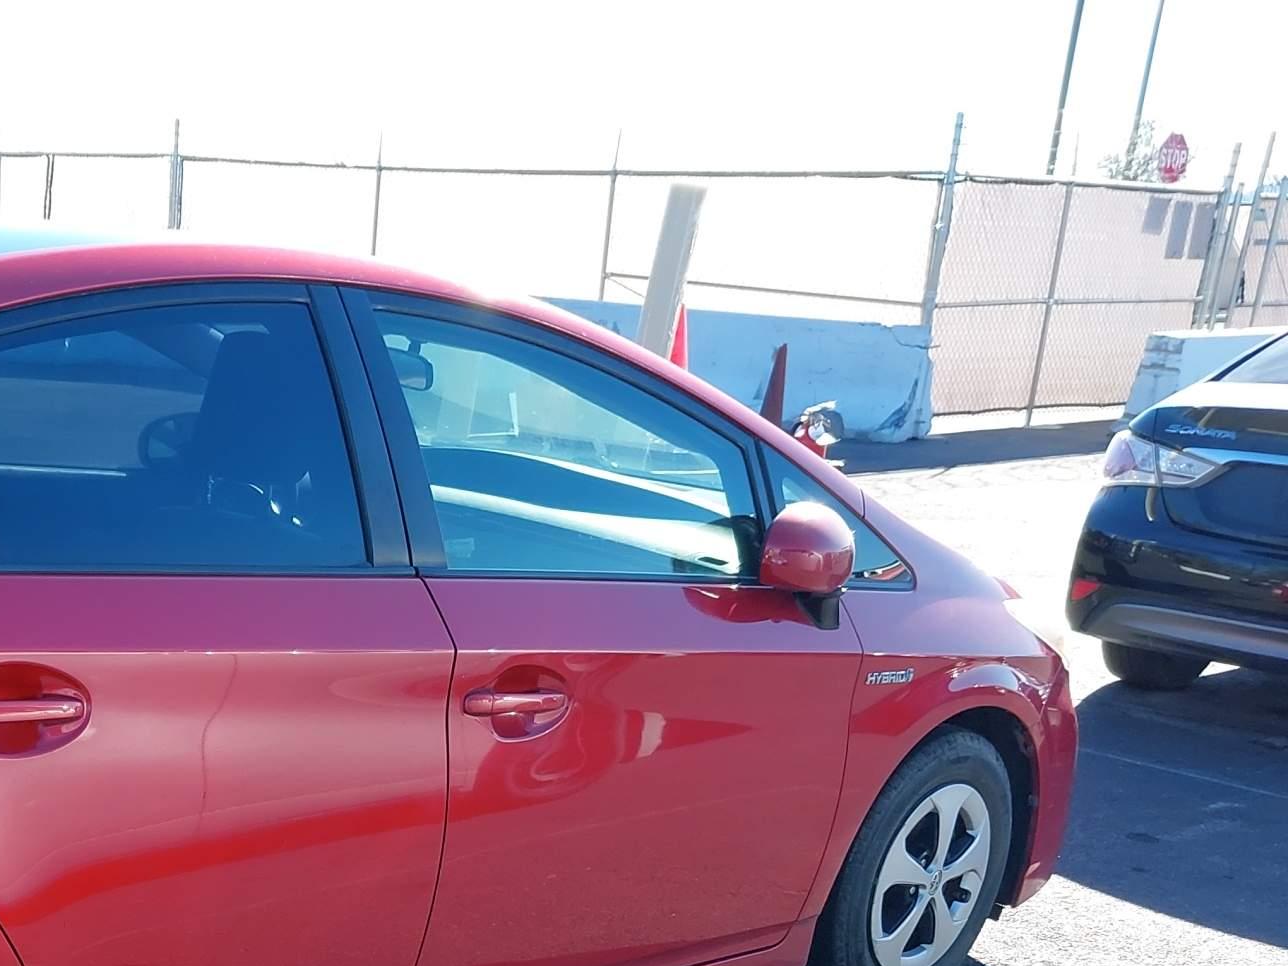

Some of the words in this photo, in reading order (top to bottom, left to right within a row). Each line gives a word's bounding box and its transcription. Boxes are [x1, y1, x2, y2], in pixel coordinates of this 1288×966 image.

[1160, 148, 1187, 170] STOP
[1164, 424, 1237, 440] SONATA
[865, 670, 907, 685] HYBRID
